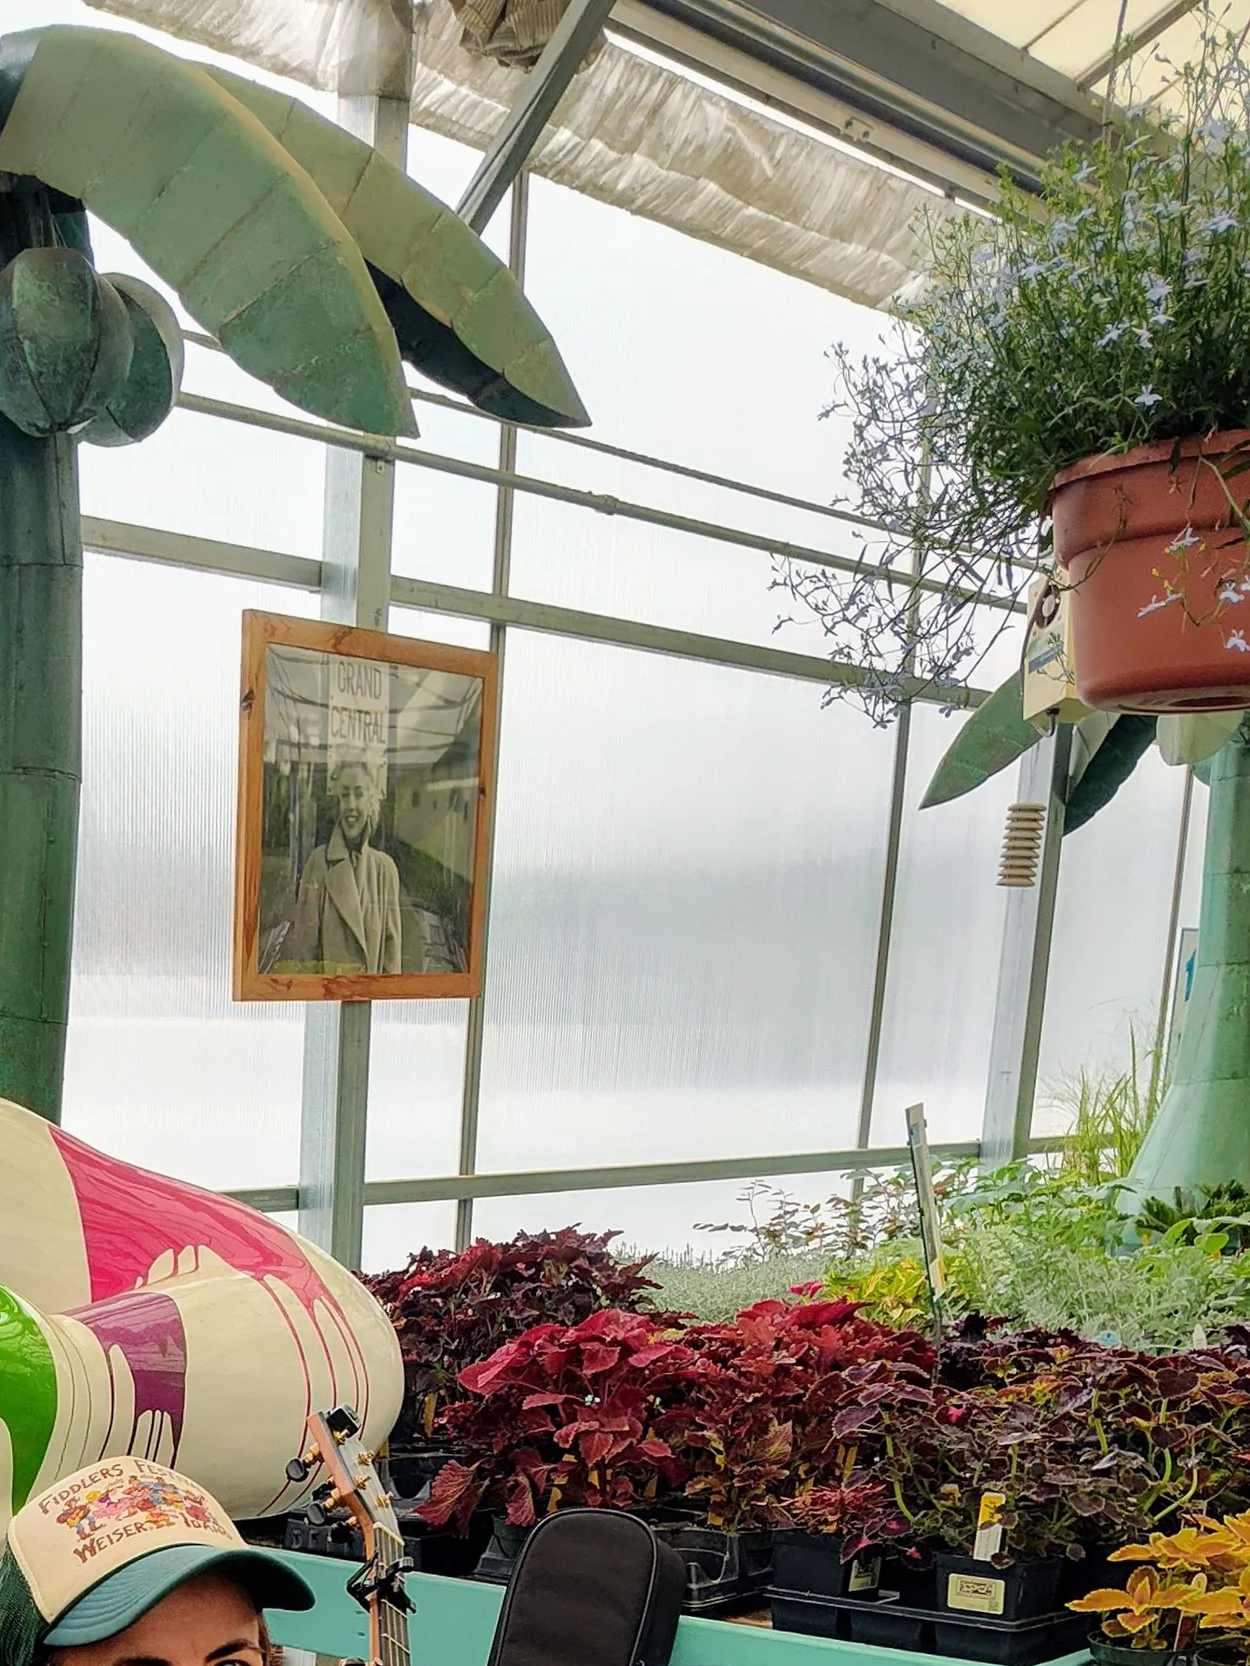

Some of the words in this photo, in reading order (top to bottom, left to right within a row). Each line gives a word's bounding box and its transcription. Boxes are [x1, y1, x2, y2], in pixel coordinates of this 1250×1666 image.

[337, 660, 383, 700] GRAND
[330, 705, 386, 745] CENTRAL
[38, 1463, 124, 1515] FIDDLERS
